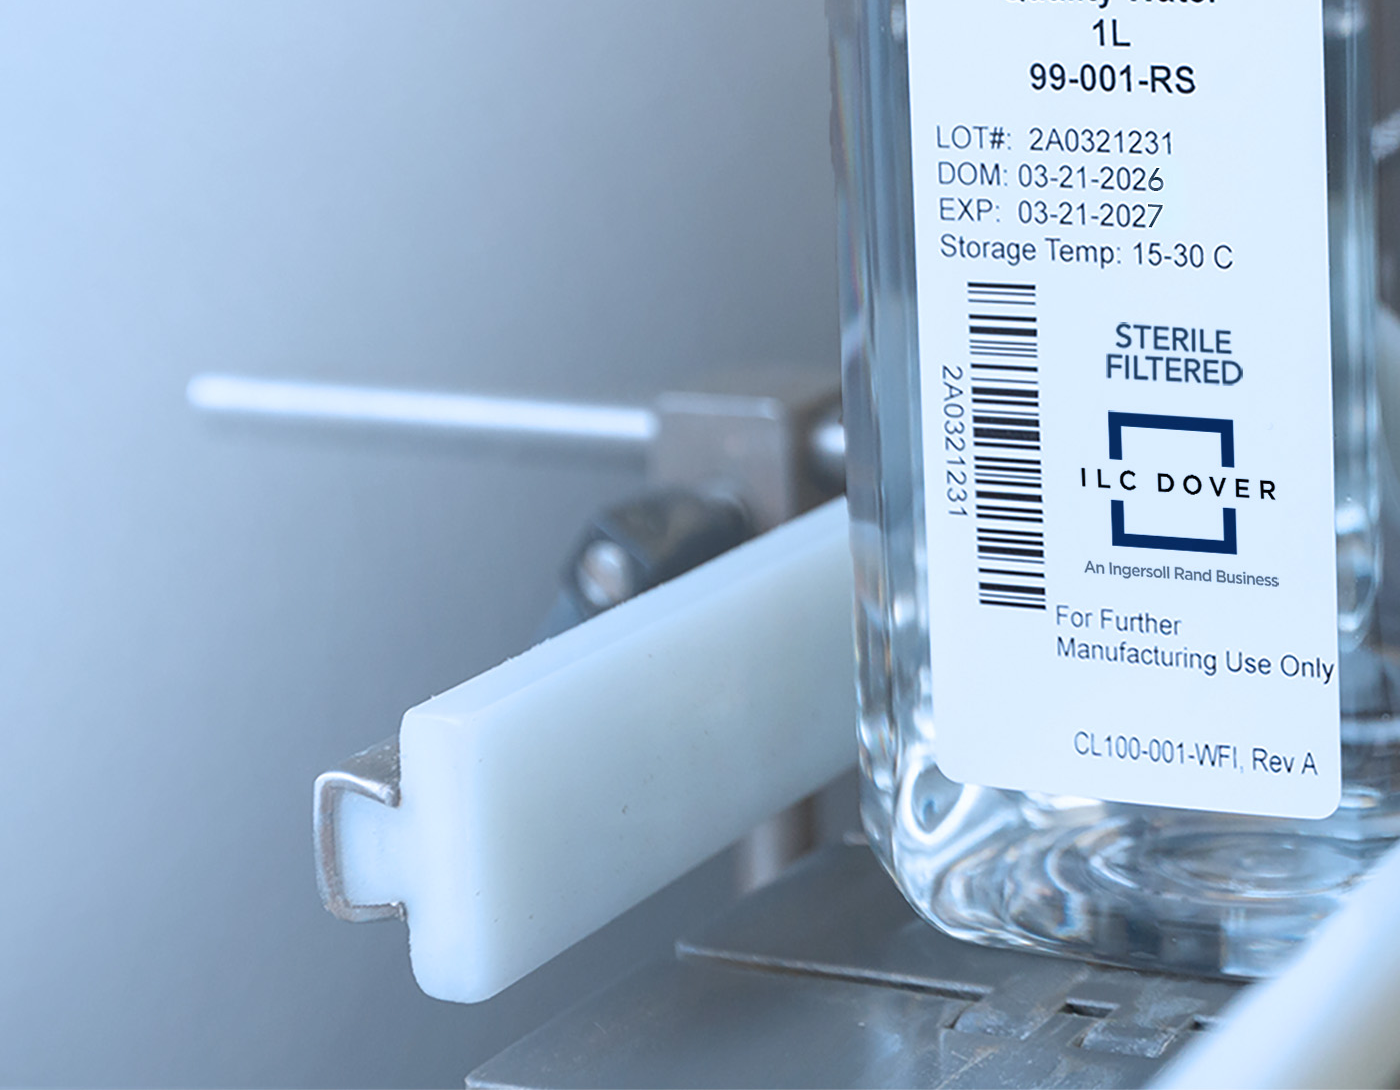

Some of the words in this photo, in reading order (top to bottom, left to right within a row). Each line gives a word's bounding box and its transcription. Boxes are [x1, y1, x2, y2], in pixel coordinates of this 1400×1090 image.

[1092, 18, 1132, 48] 1L
[1029, 62, 1197, 95] 99-001-RS
[936, 124, 1012, 151] LOT#:
[1029, 127, 1172, 156] 2A0321231
[938, 161, 1008, 187] DOM:
[1018, 163, 1164, 192] 03-21-2026
[939, 197, 1000, 223] EXP:
[1018, 199, 1164, 229] 03-21-2027
[940, 233, 1037, 267] Storage
[1044, 237, 1121, 270] Temp:
[1133, 241, 1205, 269] 15-30
[1213, 244, 1234, 270] C
[1115, 321, 1233, 355] STERILE
[1105, 353, 1244, 387] FILTERED
[942, 365, 968, 516] 2A0321231
[1080, 467, 1137, 492] ILC
[1156, 472, 1276, 501] DOVER
[1084, 560, 1105, 575] An
[1108, 561, 1170, 580] Ingersoll
[1174, 566, 1212, 583] Rand
[1216, 569, 1280, 588] Business
[1056, 604, 1093, 628] For
[1100, 608, 1182, 636] Further
[1057, 636, 1217, 677] Manufacturing
[1225, 650, 1272, 676] Use
[1280, 654, 1335, 684] Only
[1252, 747, 1295, 774] Rev
[1301, 752, 1318, 776] A
